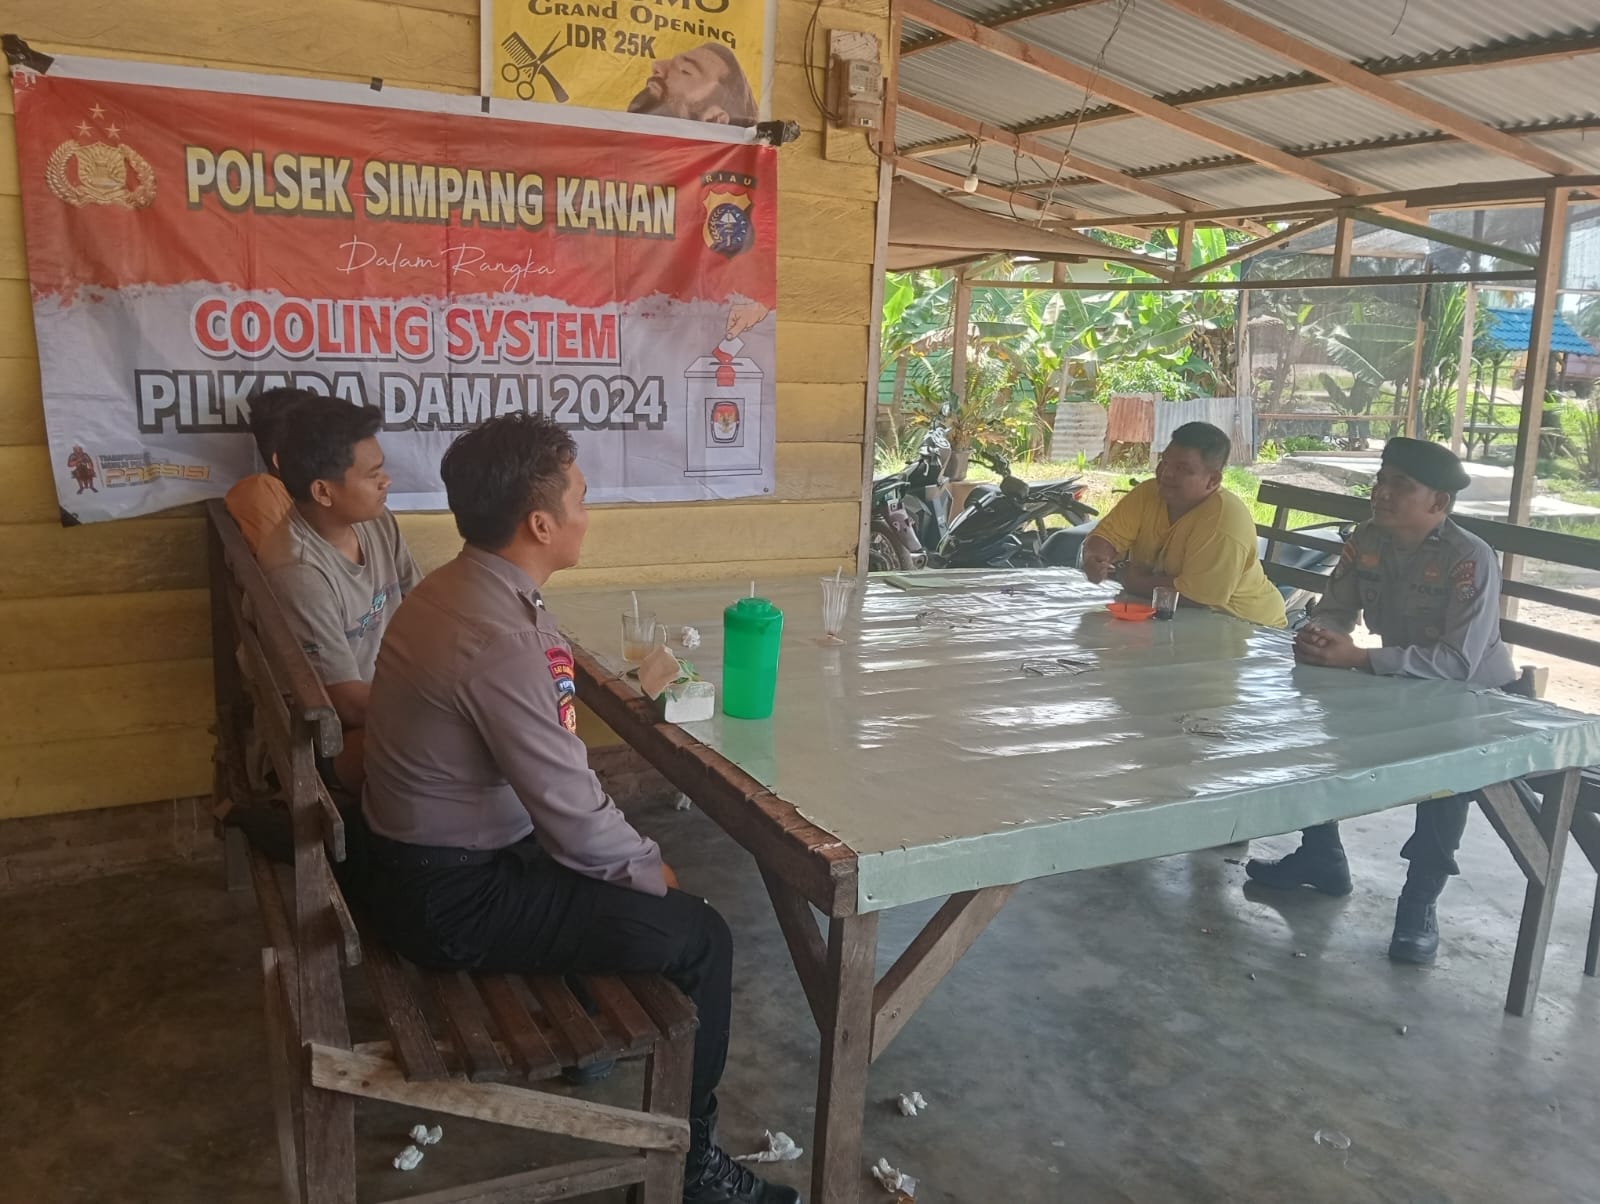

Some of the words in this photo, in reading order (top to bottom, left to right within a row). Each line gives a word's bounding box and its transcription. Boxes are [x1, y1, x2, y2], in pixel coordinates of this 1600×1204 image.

[566, 23, 606, 50] IDR
[614, 30, 656, 59] 25K
[185, 146, 353, 216] POLSEK
[364, 160, 543, 229] SIMPANG
[556, 176, 676, 237] KANAN
[705, 173, 752, 186] RIAU
[336, 234, 440, 275] Dalam
[441, 242, 555, 292] Rangka
[192, 298, 432, 359] COOLING
[443, 306, 619, 363] SYSTEM
[381, 374, 541, 428] DAMAI
[551, 375, 665, 428] 2024
